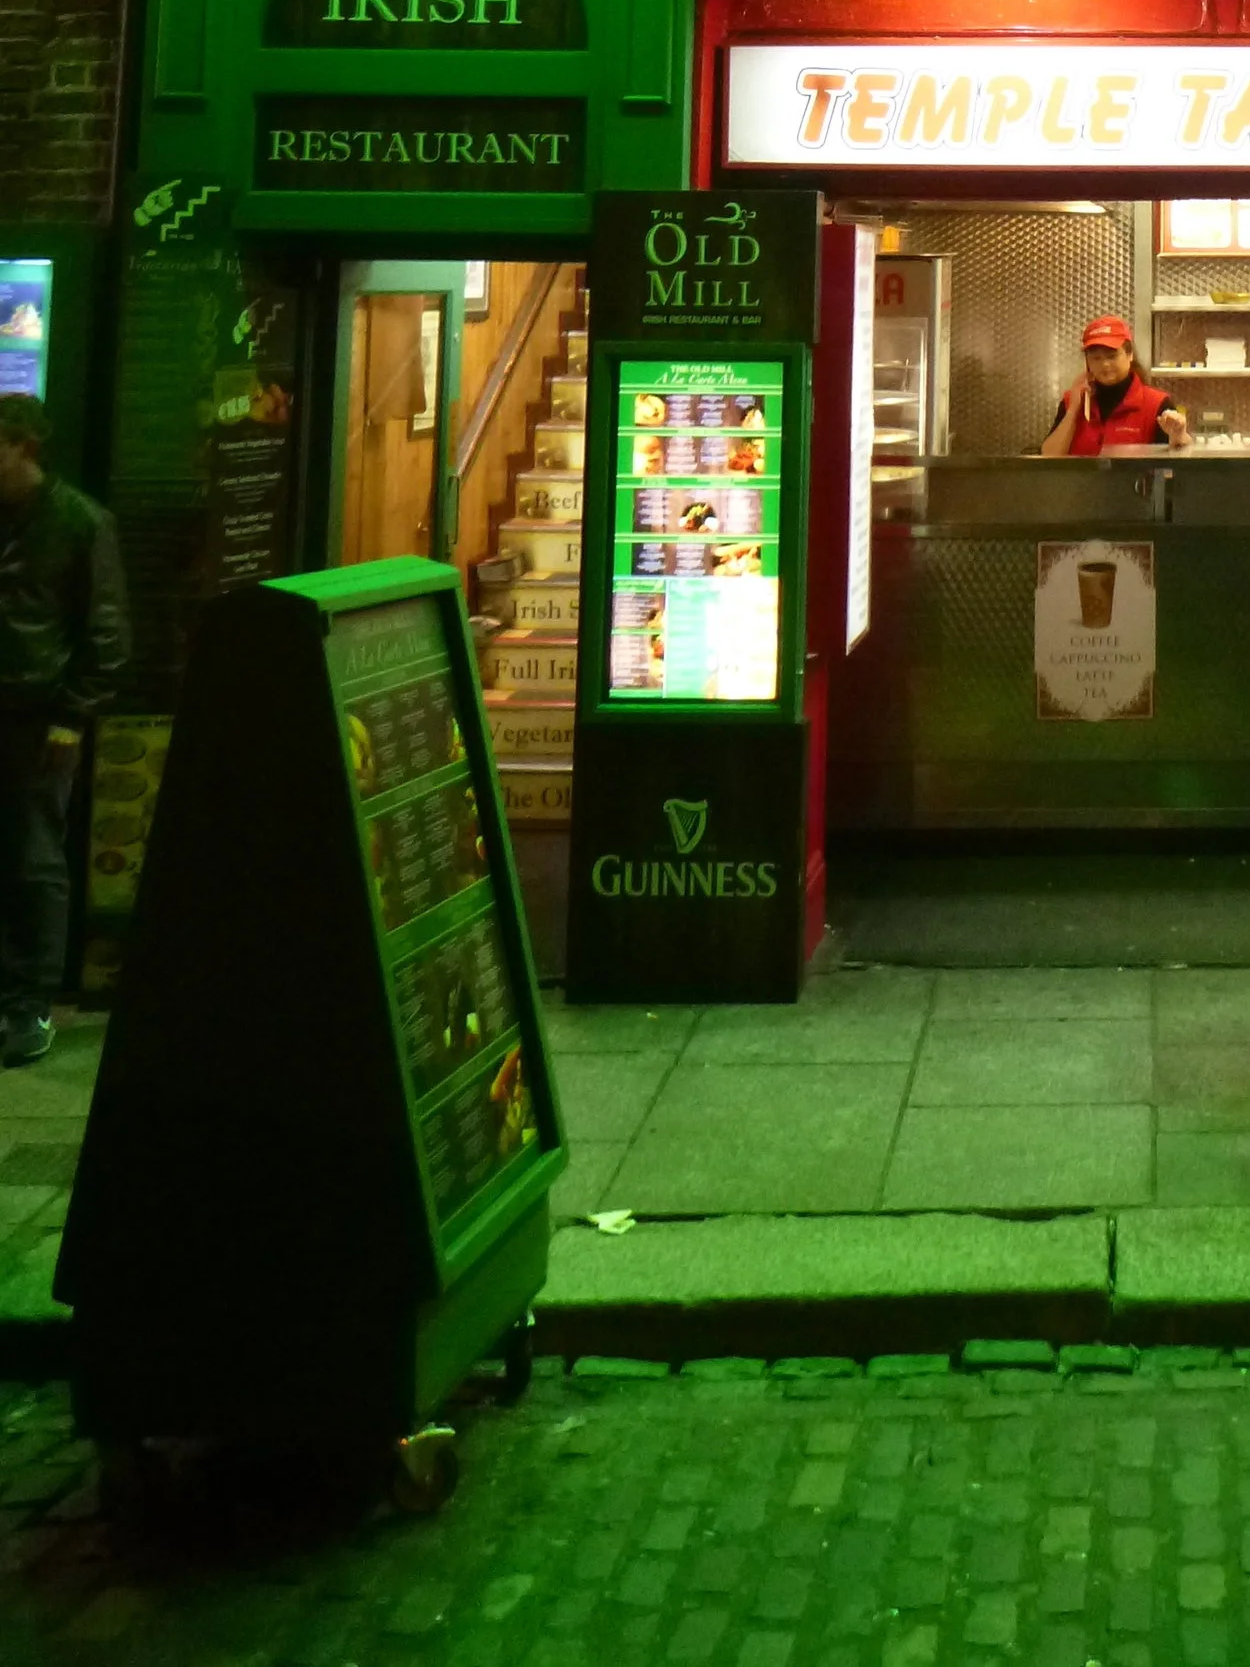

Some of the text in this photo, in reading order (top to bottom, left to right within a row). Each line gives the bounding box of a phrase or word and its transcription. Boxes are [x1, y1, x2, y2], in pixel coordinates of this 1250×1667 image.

[797, 67, 1142, 150] TEMPLE
[268, 130, 570, 165] RESTAURANT
[645, 222, 760, 267] OLD
[645, 270, 760, 307] MILL
[669, 315, 729, 324] RESTAURANT
[742, 315, 761, 324] BAR
[533, 489, 582, 509] Beef
[511, 600, 560, 619] Irish
[1070, 635, 1120, 648] COFFEE
[494, 659, 575, 680] Full Iri
[1050, 653, 1142, 665] CAPPUCCINO
[1076, 670, 1115, 681] LATTE
[1083, 687, 1108, 698] TEA
[490, 722, 574, 748] Vegetar
[505, 786, 571, 809] he Ol
[592, 854, 778, 898] GUINNESS
